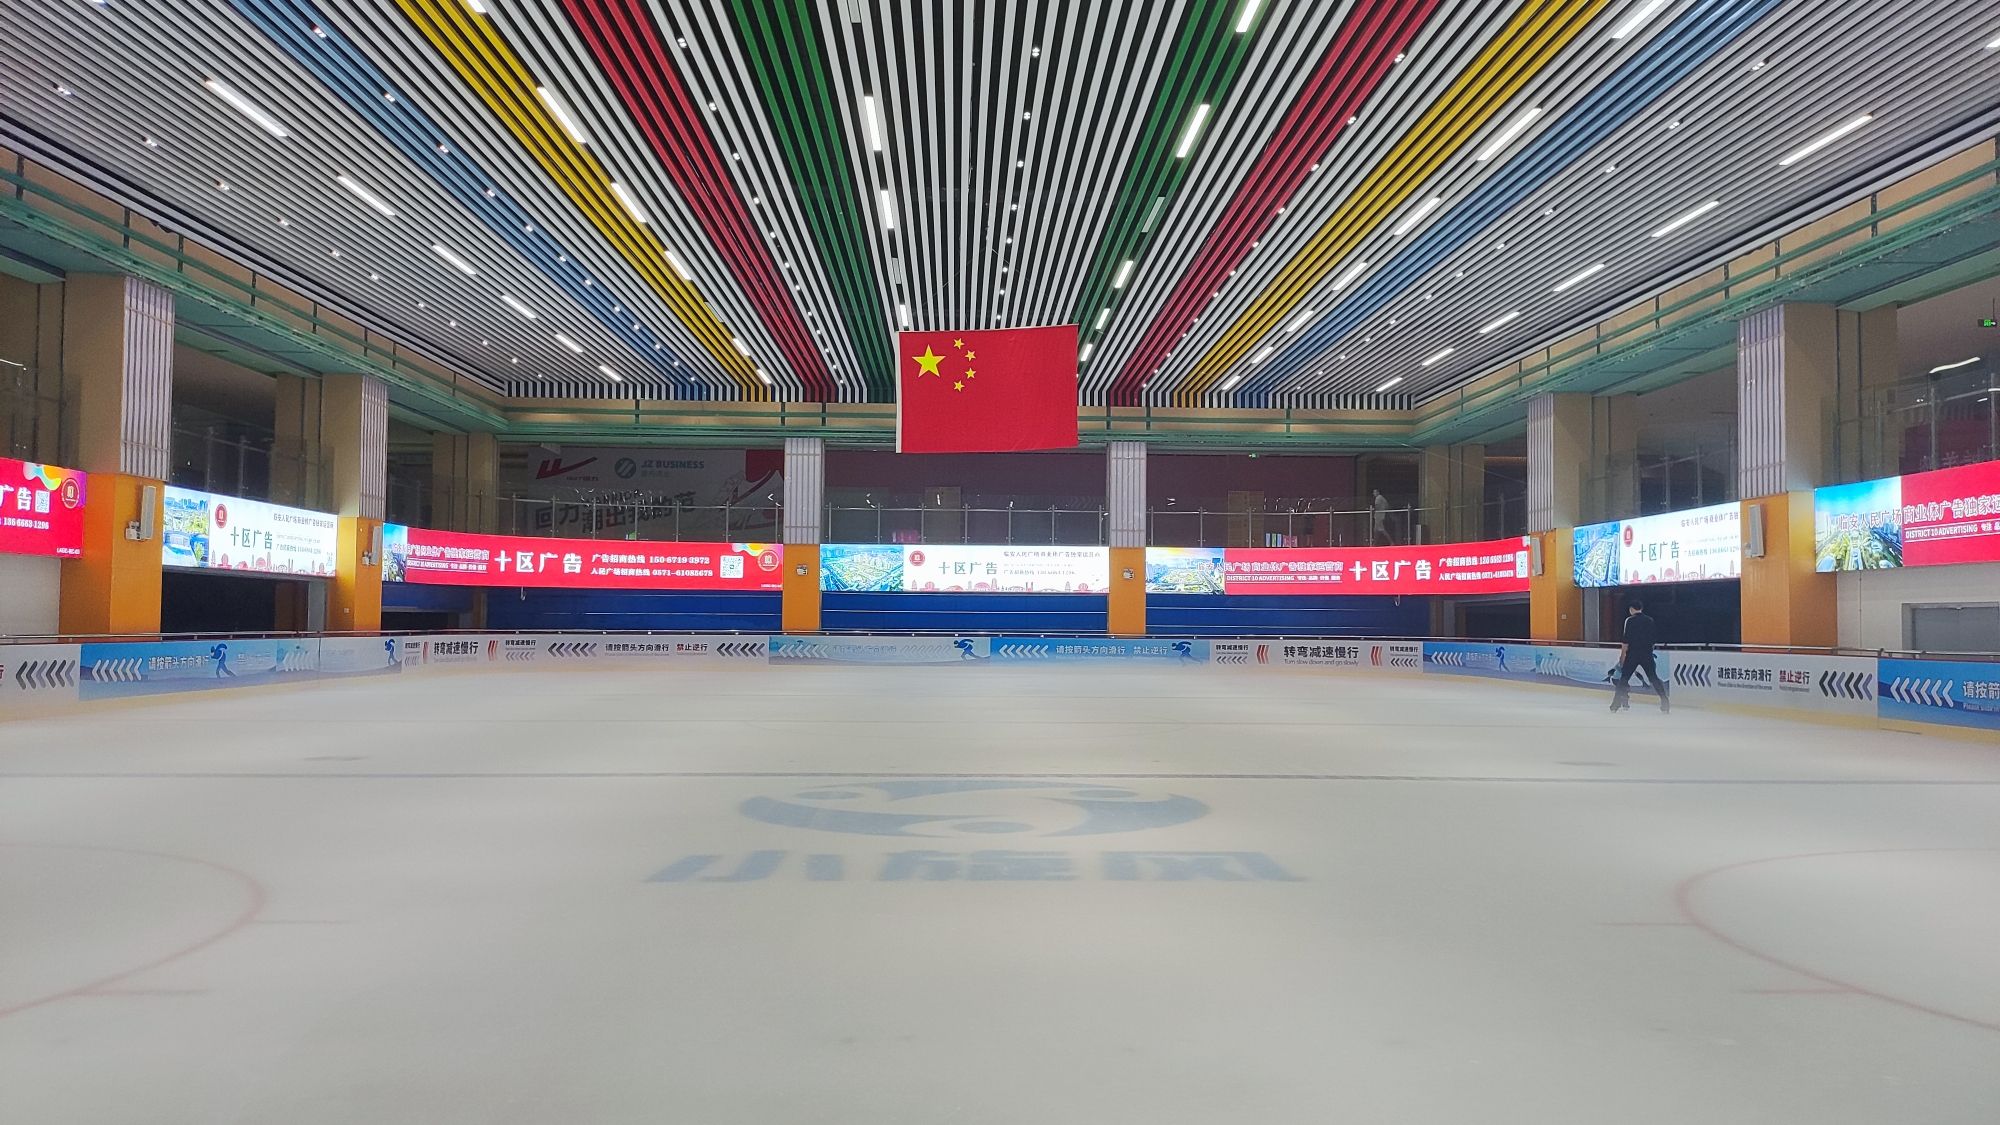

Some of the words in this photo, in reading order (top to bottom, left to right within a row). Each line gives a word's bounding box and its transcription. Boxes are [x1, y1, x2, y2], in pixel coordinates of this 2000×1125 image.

[656, 460, 705, 469] BUSINESS
[230, 526, 273, 550] 十区广告
[1906, 529, 1930, 539] DISTRICT
[1939, 524, 1978, 535] ADVERTISING
[1638, 541, 1680, 562] 十区广告
[494, 550, 582, 574] 十区广告
[591, 554, 646, 564] 广告招商热线
[939, 561, 998, 575] 十区广告
[1348, 560, 1432, 581] 十区广告
[434, 641, 479, 655] 转弯减速慢行
[605, 643, 669, 652] 请按箭头方向滑行
[676, 643, 708, 652] 禁止逆行
[1056, 645, 1126, 655] 请按箭头方向滑行
[1133, 646, 1168, 655] 禁止逆行
[1283, 646, 1359, 659] 转弯减速慢行
[1717, 667, 1772, 682] 请按箭头方向滑行
[1779, 669, 1810, 685] 禁止逆行
[1963, 681, 2000, 700] 请按箭
